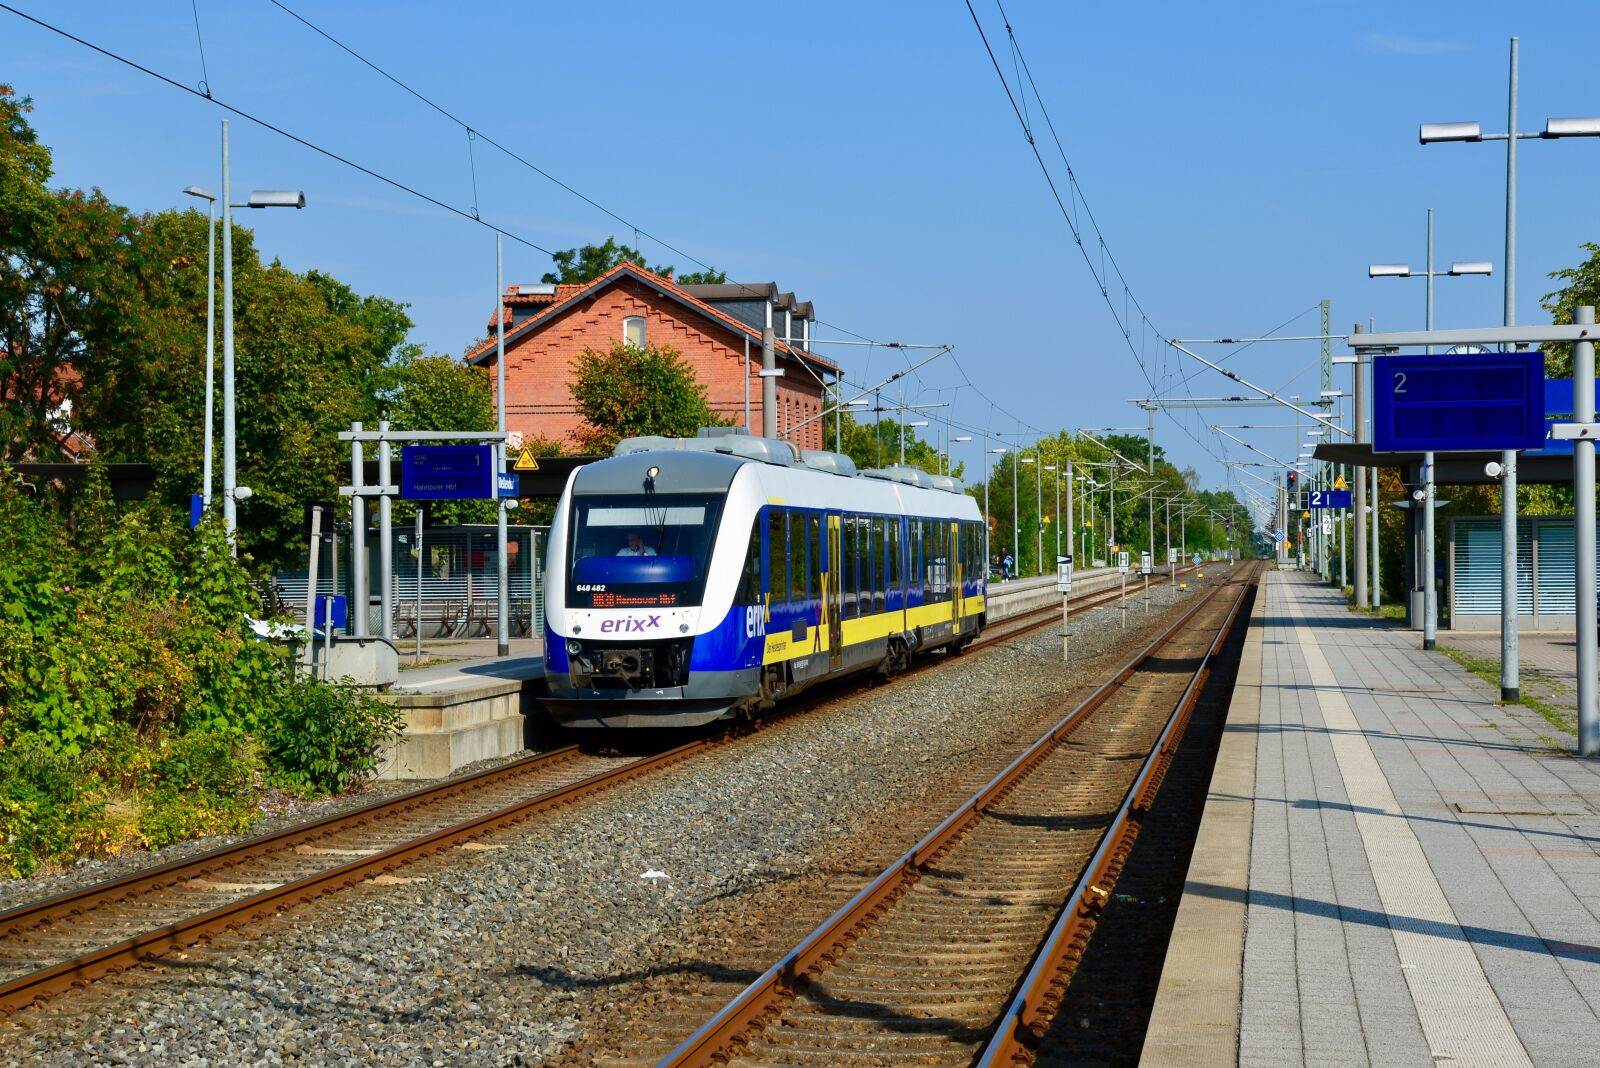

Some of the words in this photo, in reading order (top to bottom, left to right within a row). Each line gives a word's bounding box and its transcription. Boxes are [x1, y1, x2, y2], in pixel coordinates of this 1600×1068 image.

[1393, 372, 1407, 393] 2
[475, 454, 480, 467] 1
[445, 483, 457, 491] Hbf
[1311, 491, 1322, 505] 2
[1119, 553, 1128, 565] H
[1058, 565, 1070, 582] H
[616, 594, 658, 605] Hannover
[659, 593, 677, 604] Hbf
[746, 592, 770, 638] erixx
[600, 615, 661, 633] erixx
